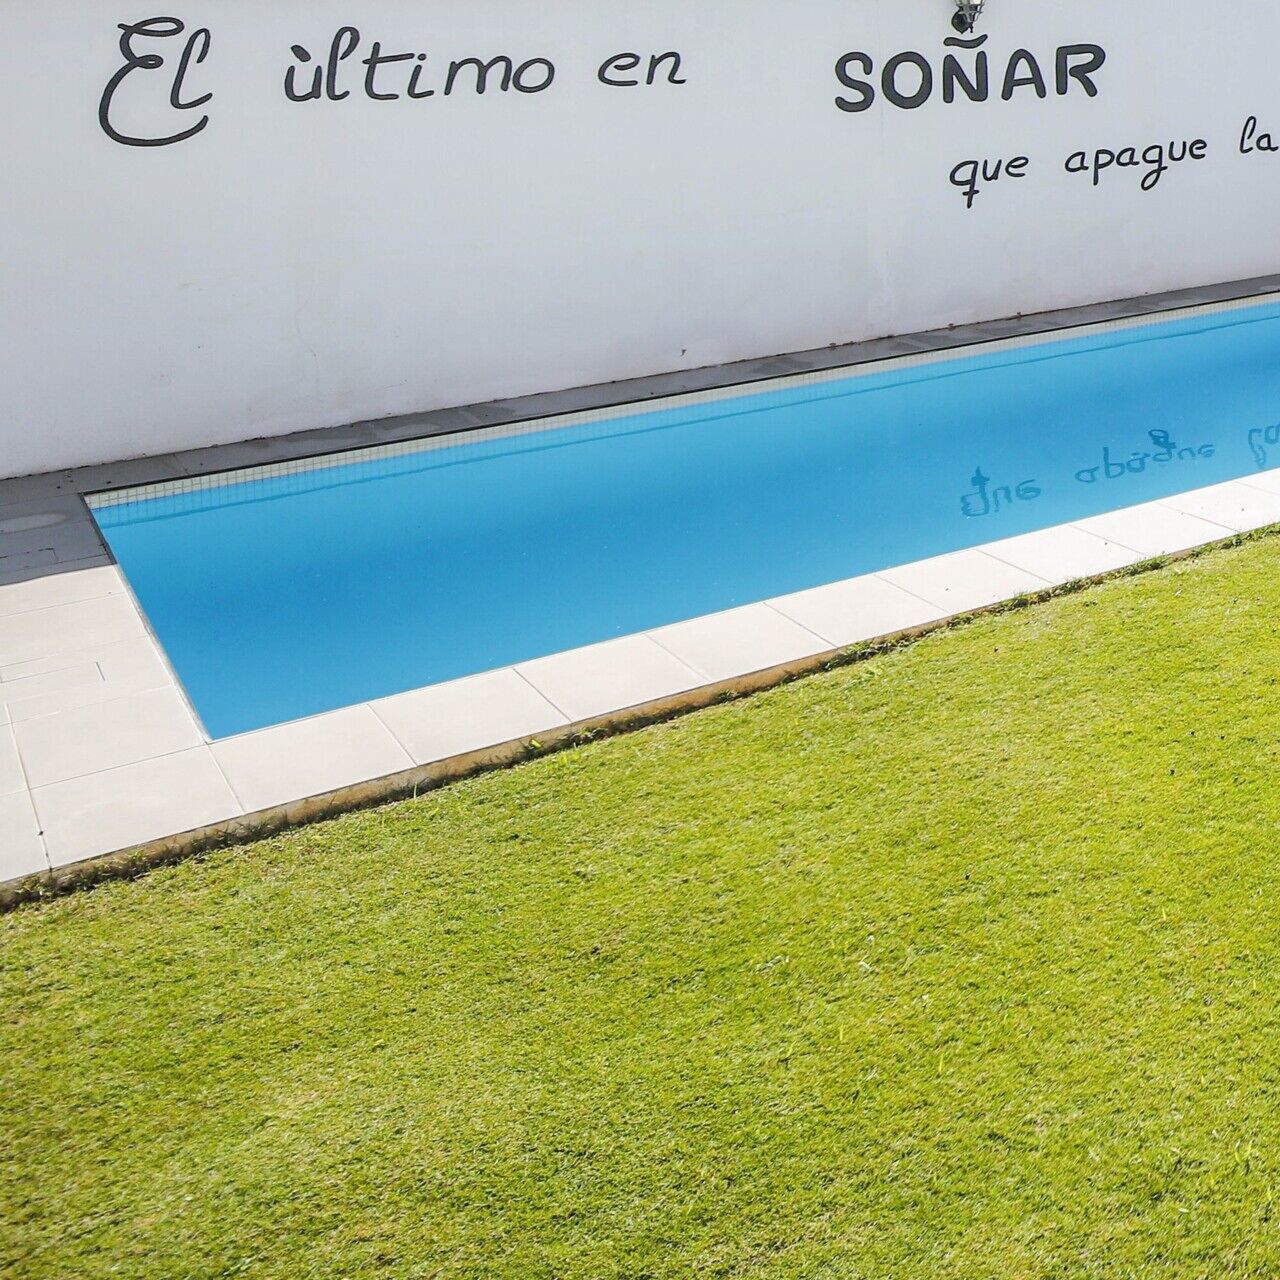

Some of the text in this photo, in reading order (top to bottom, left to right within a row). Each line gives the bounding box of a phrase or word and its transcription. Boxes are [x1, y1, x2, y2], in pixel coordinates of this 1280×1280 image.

[99, 17, 212, 147] El
[597, 51, 687, 87] en
[834, 34, 1106, 113] SOÑAR
[949, 156, 1030, 209] que
[1064, 137, 1208, 191] apague
[1239, 116, 1280, 154] la
